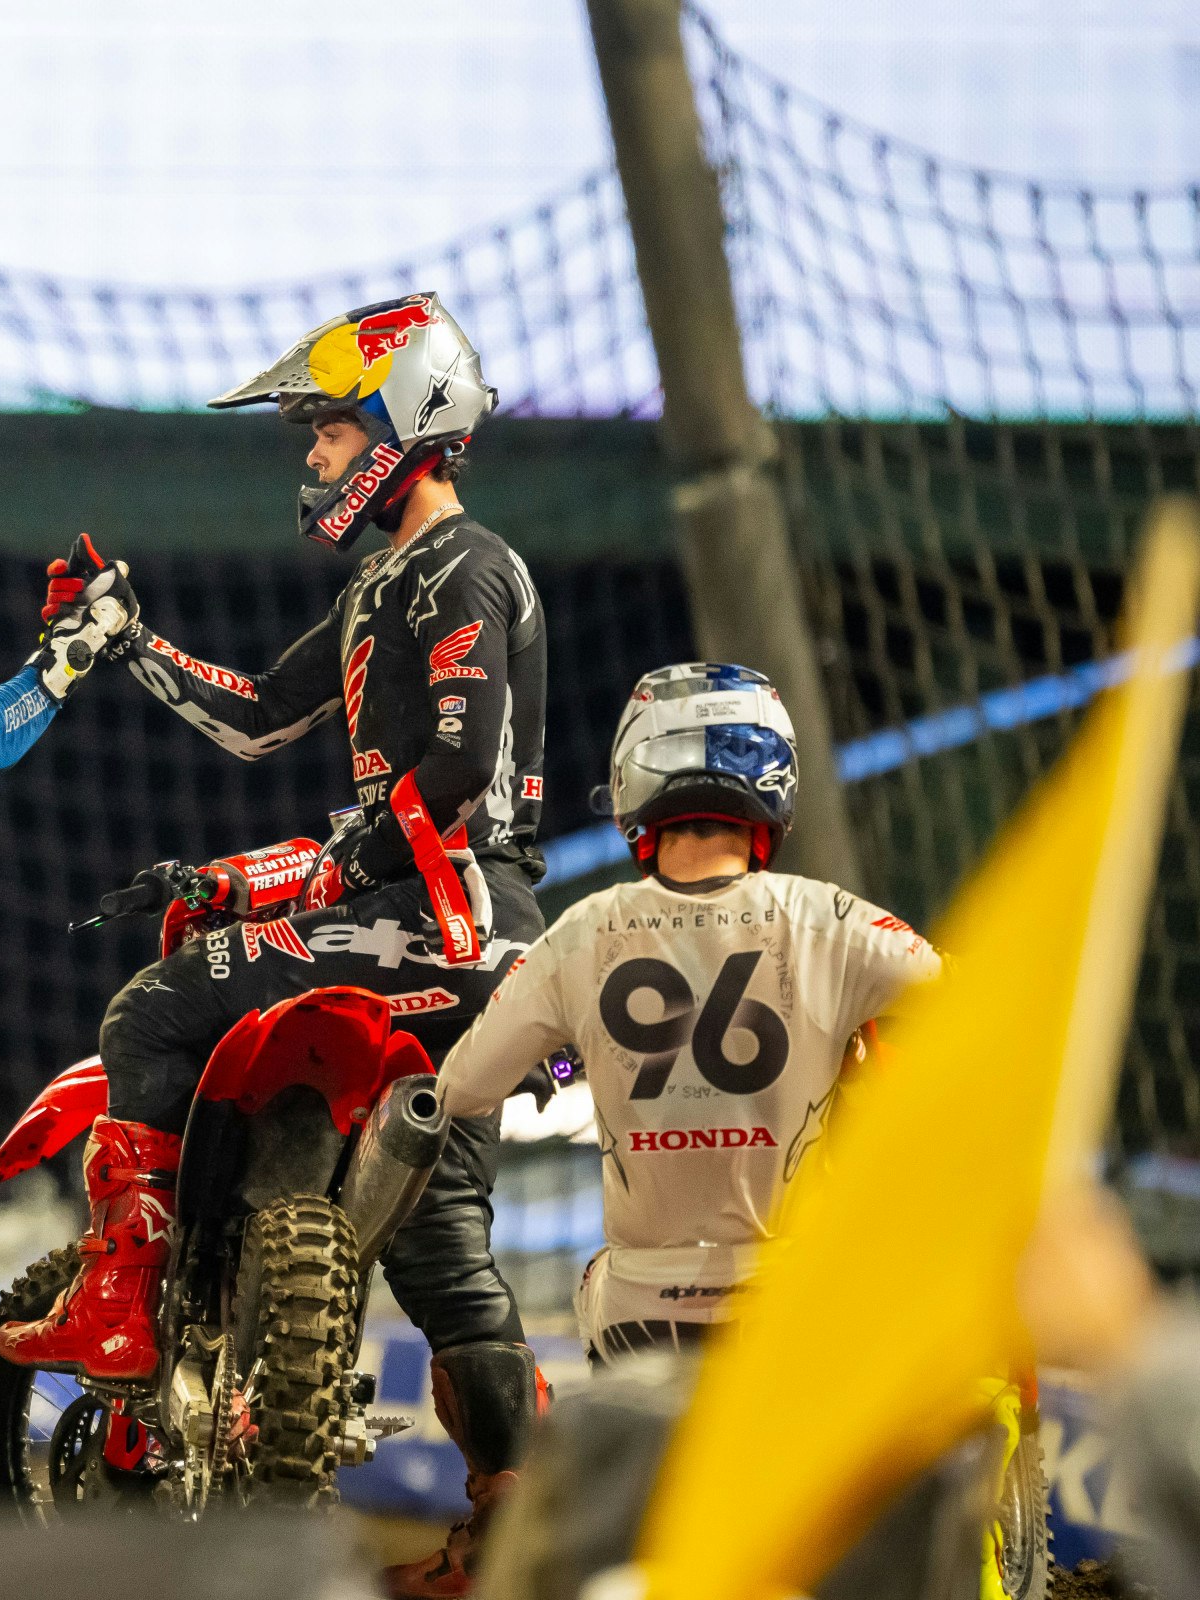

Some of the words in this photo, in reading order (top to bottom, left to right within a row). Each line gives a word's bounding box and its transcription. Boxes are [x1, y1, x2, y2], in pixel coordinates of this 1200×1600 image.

[318, 485, 367, 540] Red
[349, 444, 404, 497] Bull
[430, 664, 486, 686] HONDA
[608, 910, 775, 932] LAWRENCE
[447, 920, 468, 952] 100%
[599, 950, 790, 1100] 96
[629, 1127, 778, 1152] HONDA
